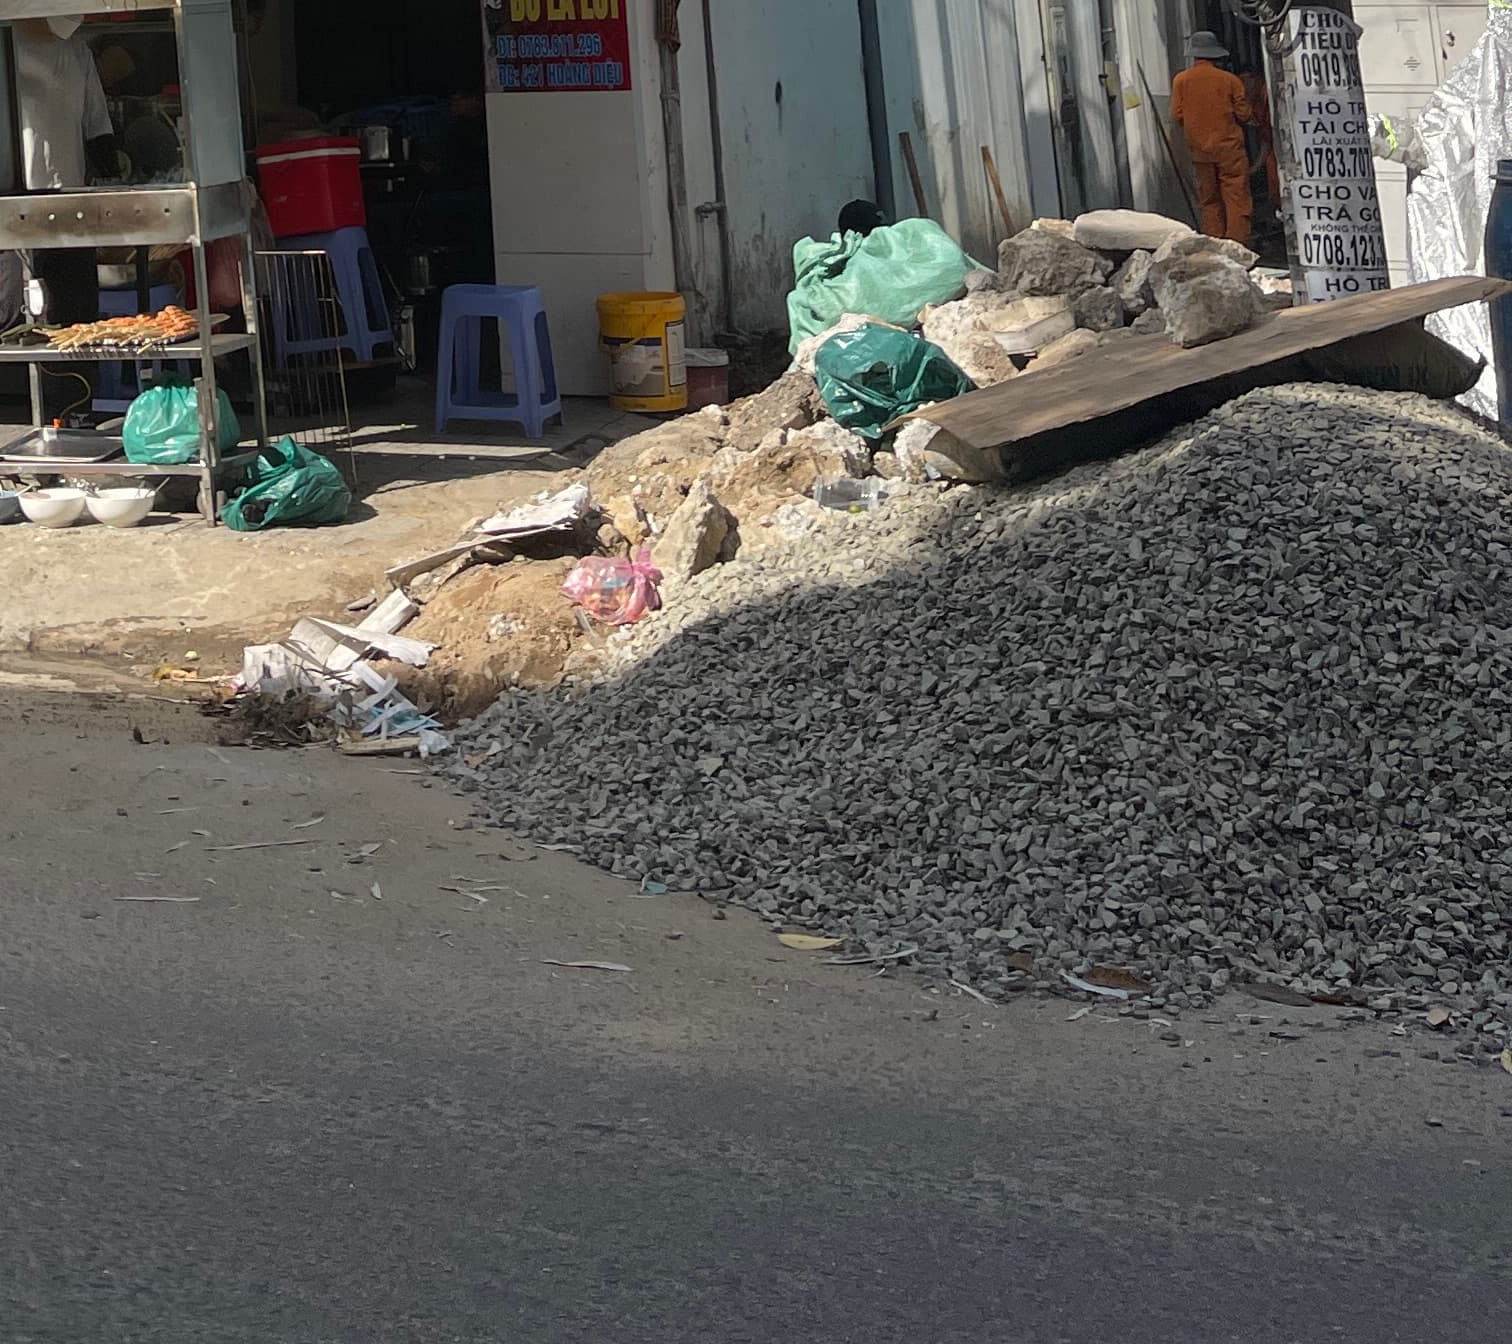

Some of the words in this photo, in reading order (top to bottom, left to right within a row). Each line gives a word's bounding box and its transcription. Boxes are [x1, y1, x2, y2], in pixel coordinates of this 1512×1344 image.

[1302, 11, 1345, 29] CHO
[1299, 117, 1336, 135] TÀI
[1298, 184, 1351, 201] CHO
[1357, 185, 1377, 201] VA
